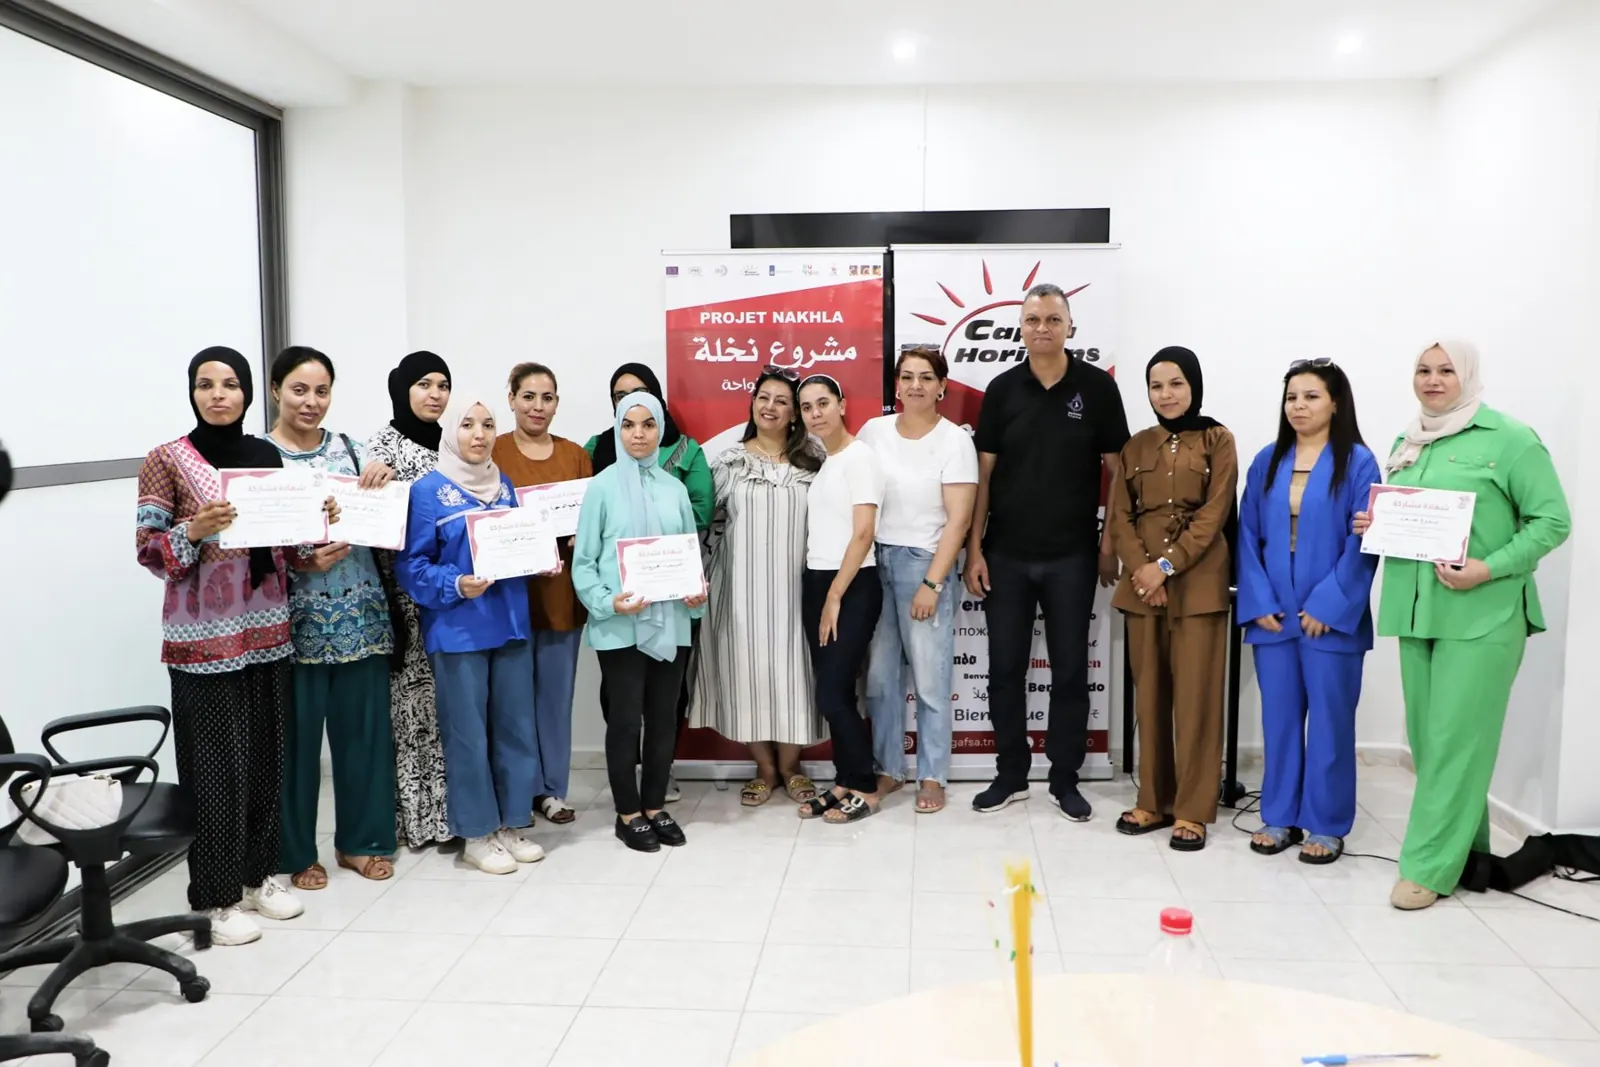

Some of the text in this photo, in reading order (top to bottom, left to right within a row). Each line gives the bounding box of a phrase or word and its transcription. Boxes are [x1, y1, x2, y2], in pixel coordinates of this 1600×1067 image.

[700, 311, 844, 324] PROJET NAKHLA
[692, 336, 858, 368] مشروع نخلة
